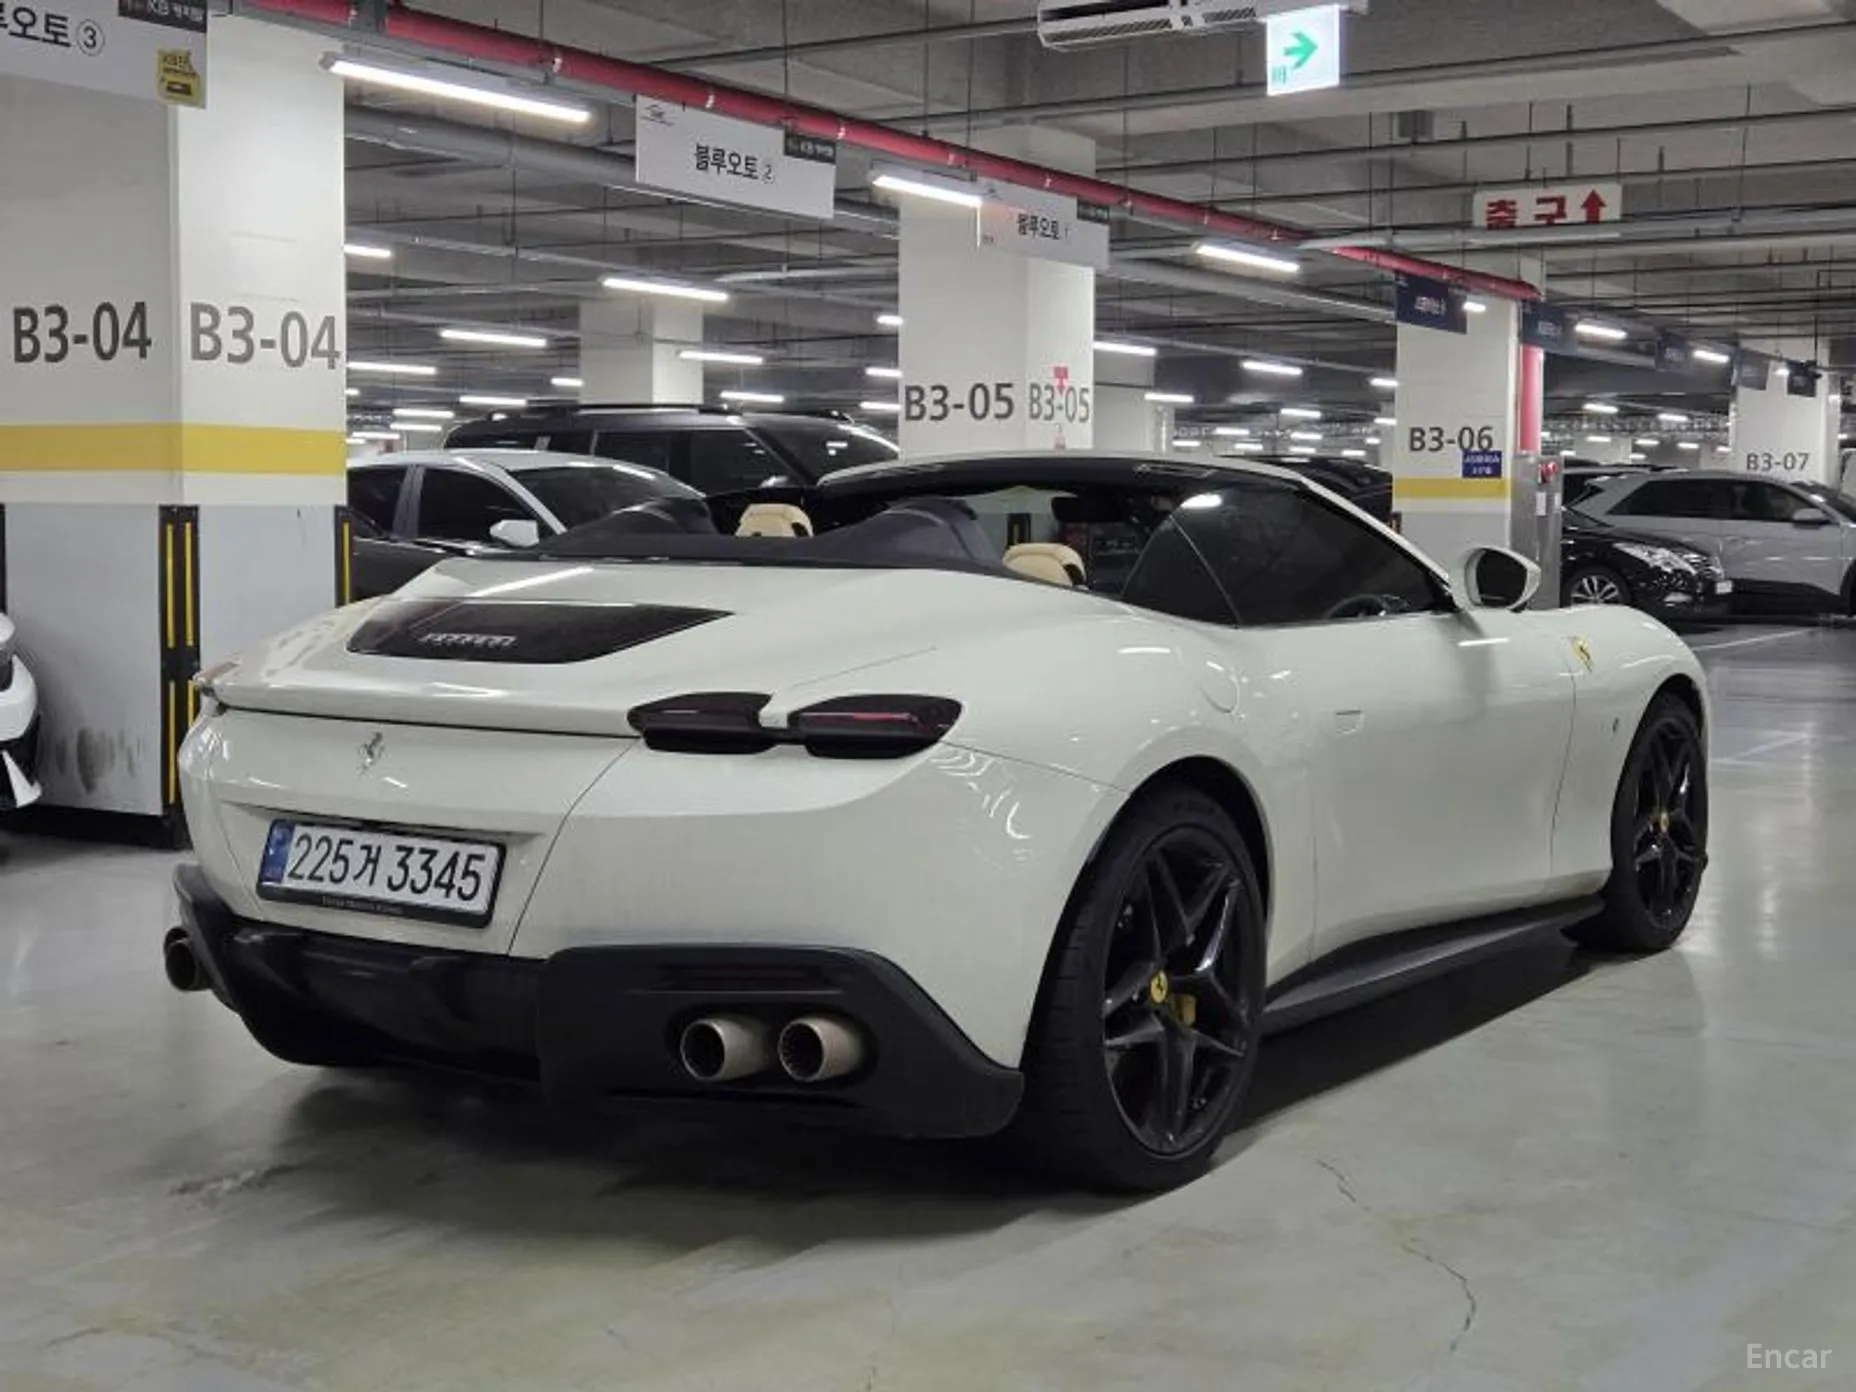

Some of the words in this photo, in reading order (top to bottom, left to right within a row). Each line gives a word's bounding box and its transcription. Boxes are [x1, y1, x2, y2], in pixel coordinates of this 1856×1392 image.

[13, 301, 152, 364] B3-04
[190, 302, 341, 370] B3-04
[904, 383, 1014, 421] B3-05
[1029, 382, 1089, 423] B3-05
[1409, 426, 1493, 452] B3-06
[1746, 452, 1809, 471] B3-07
[387, 844, 485, 901] 3345
